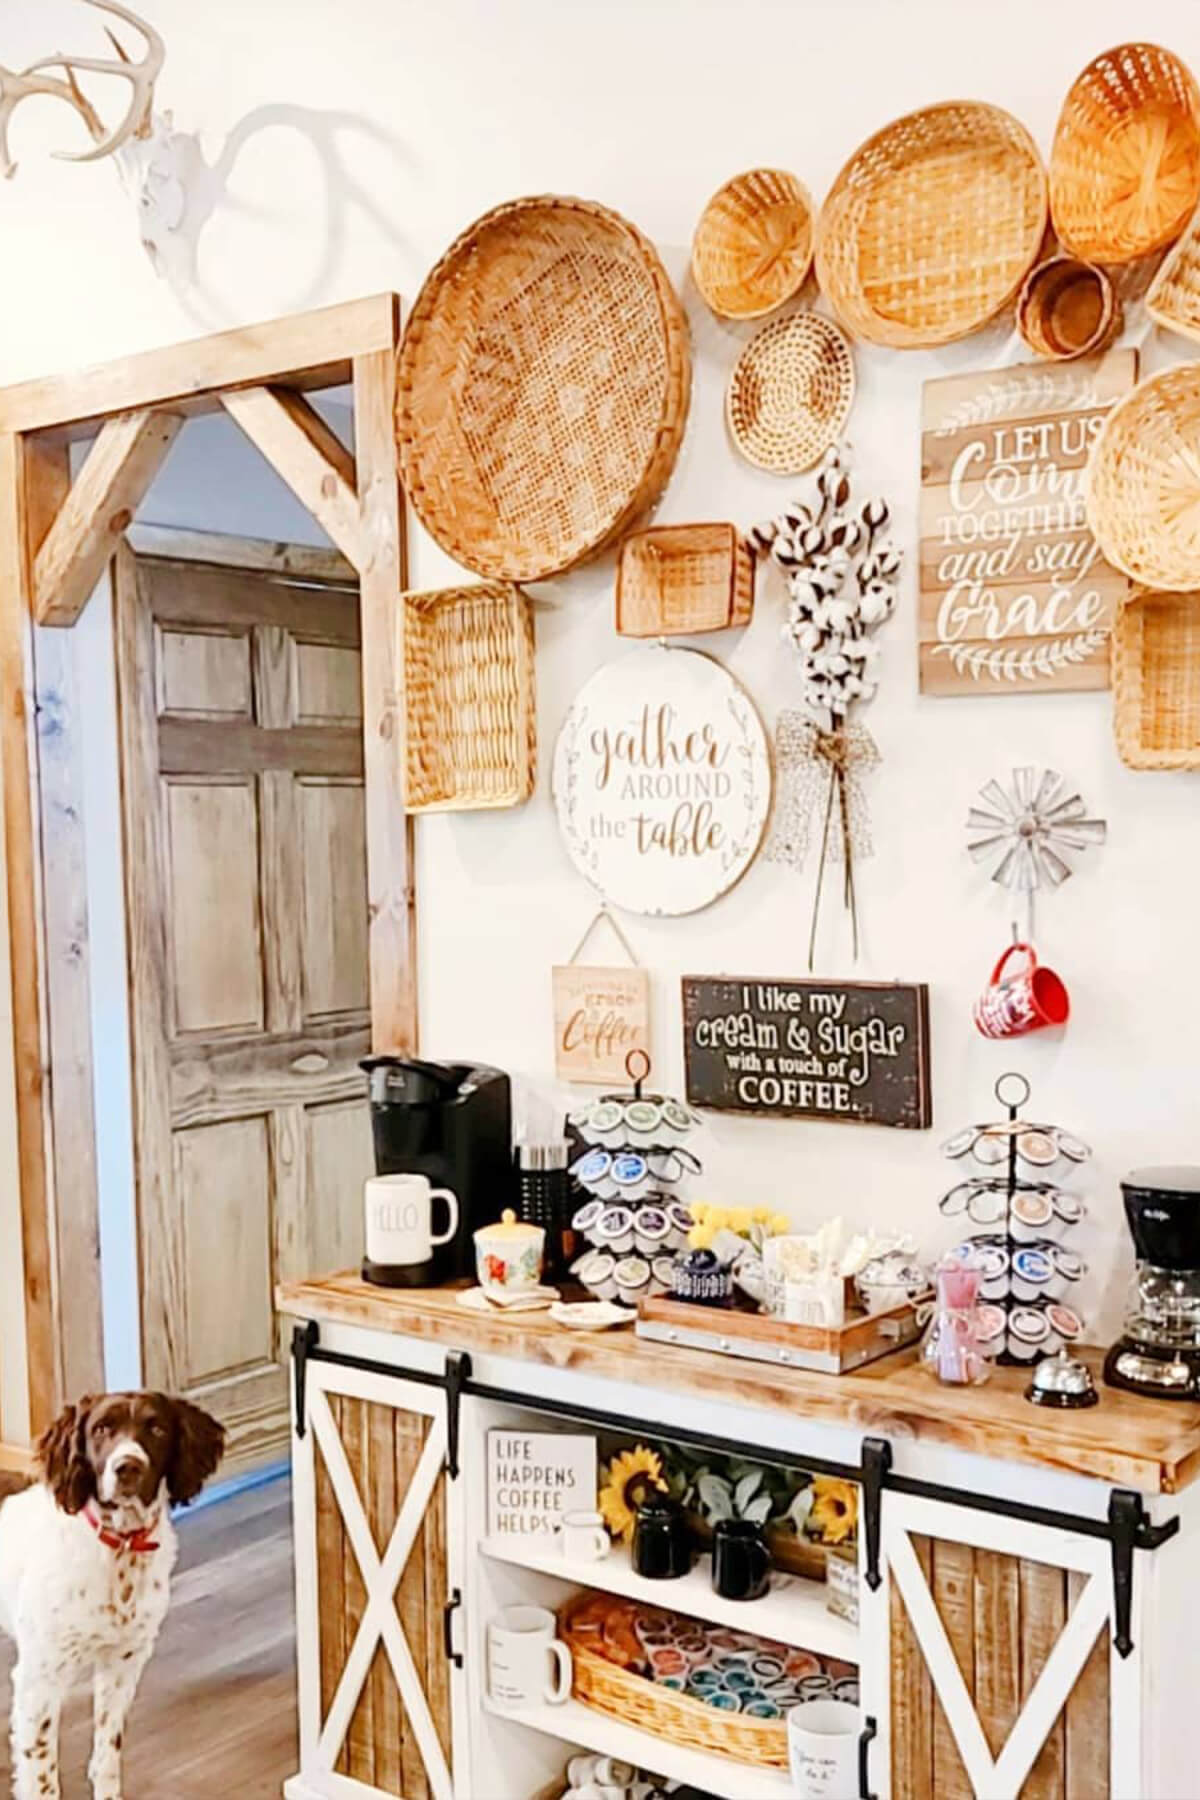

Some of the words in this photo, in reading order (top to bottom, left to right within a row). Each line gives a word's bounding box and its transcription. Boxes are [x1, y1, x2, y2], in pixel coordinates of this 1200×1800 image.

[994, 423, 1055, 464] LET
[1060, 415, 1106, 456] US
[950, 441, 1088, 512] Com
[936, 500, 1088, 546] TOGETHE
[938, 532, 1022, 582] and
[1027, 540, 1098, 589] say
[936, 580, 1105, 642] Grace
[590, 703, 731, 791] gather
[621, 773, 732, 800] AROUND
[589, 813, 626, 839] the
[630, 801, 726, 857] table
[743, 986, 750, 1010] I
[758, 986, 801, 1011] like
[809, 993, 847, 1018] my
[696, 1014, 779, 1049] cream
[787, 1018, 812, 1054] &
[817, 1018, 905, 1085] Sugar
[726, 1052, 761, 1073] with
[766, 1060, 776, 1073] a
[779, 1055, 824, 1076] touch
[828, 1058, 849, 1077] of
[738, 1077, 861, 1112] COFFEE.
[496, 1439, 532, 1459] LIFE
[496, 1464, 577, 1488] HAPPENS
[496, 1488, 563, 1511] COFFEE
[496, 1513, 551, 1534] HELPS
